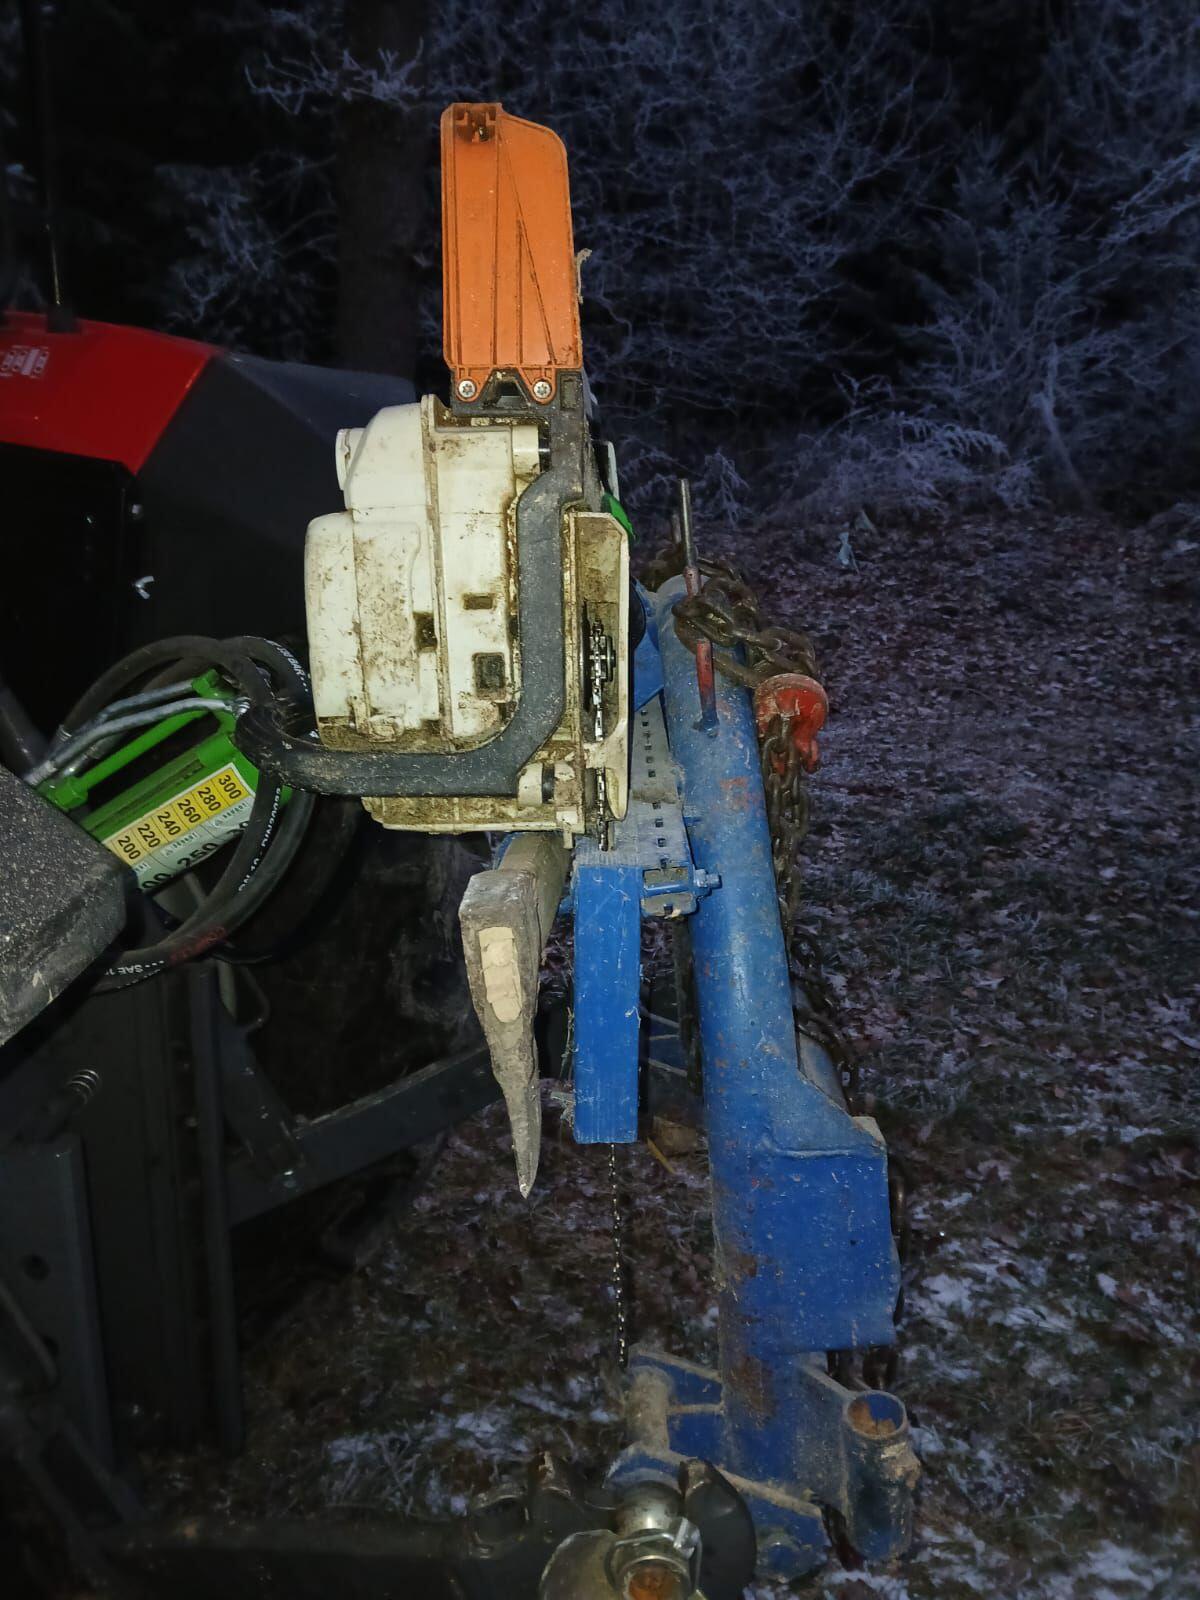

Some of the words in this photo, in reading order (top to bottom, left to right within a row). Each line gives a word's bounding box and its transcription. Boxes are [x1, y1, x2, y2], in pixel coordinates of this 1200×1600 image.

[198, 787, 221, 812] 280
[219, 775, 242, 800] 300
[158, 811, 181, 836] 240
[178, 799, 201, 824] 260
[118, 835, 141, 860] 200
[138, 823, 161, 848] 220
[118, 964, 145, 976] SAE
